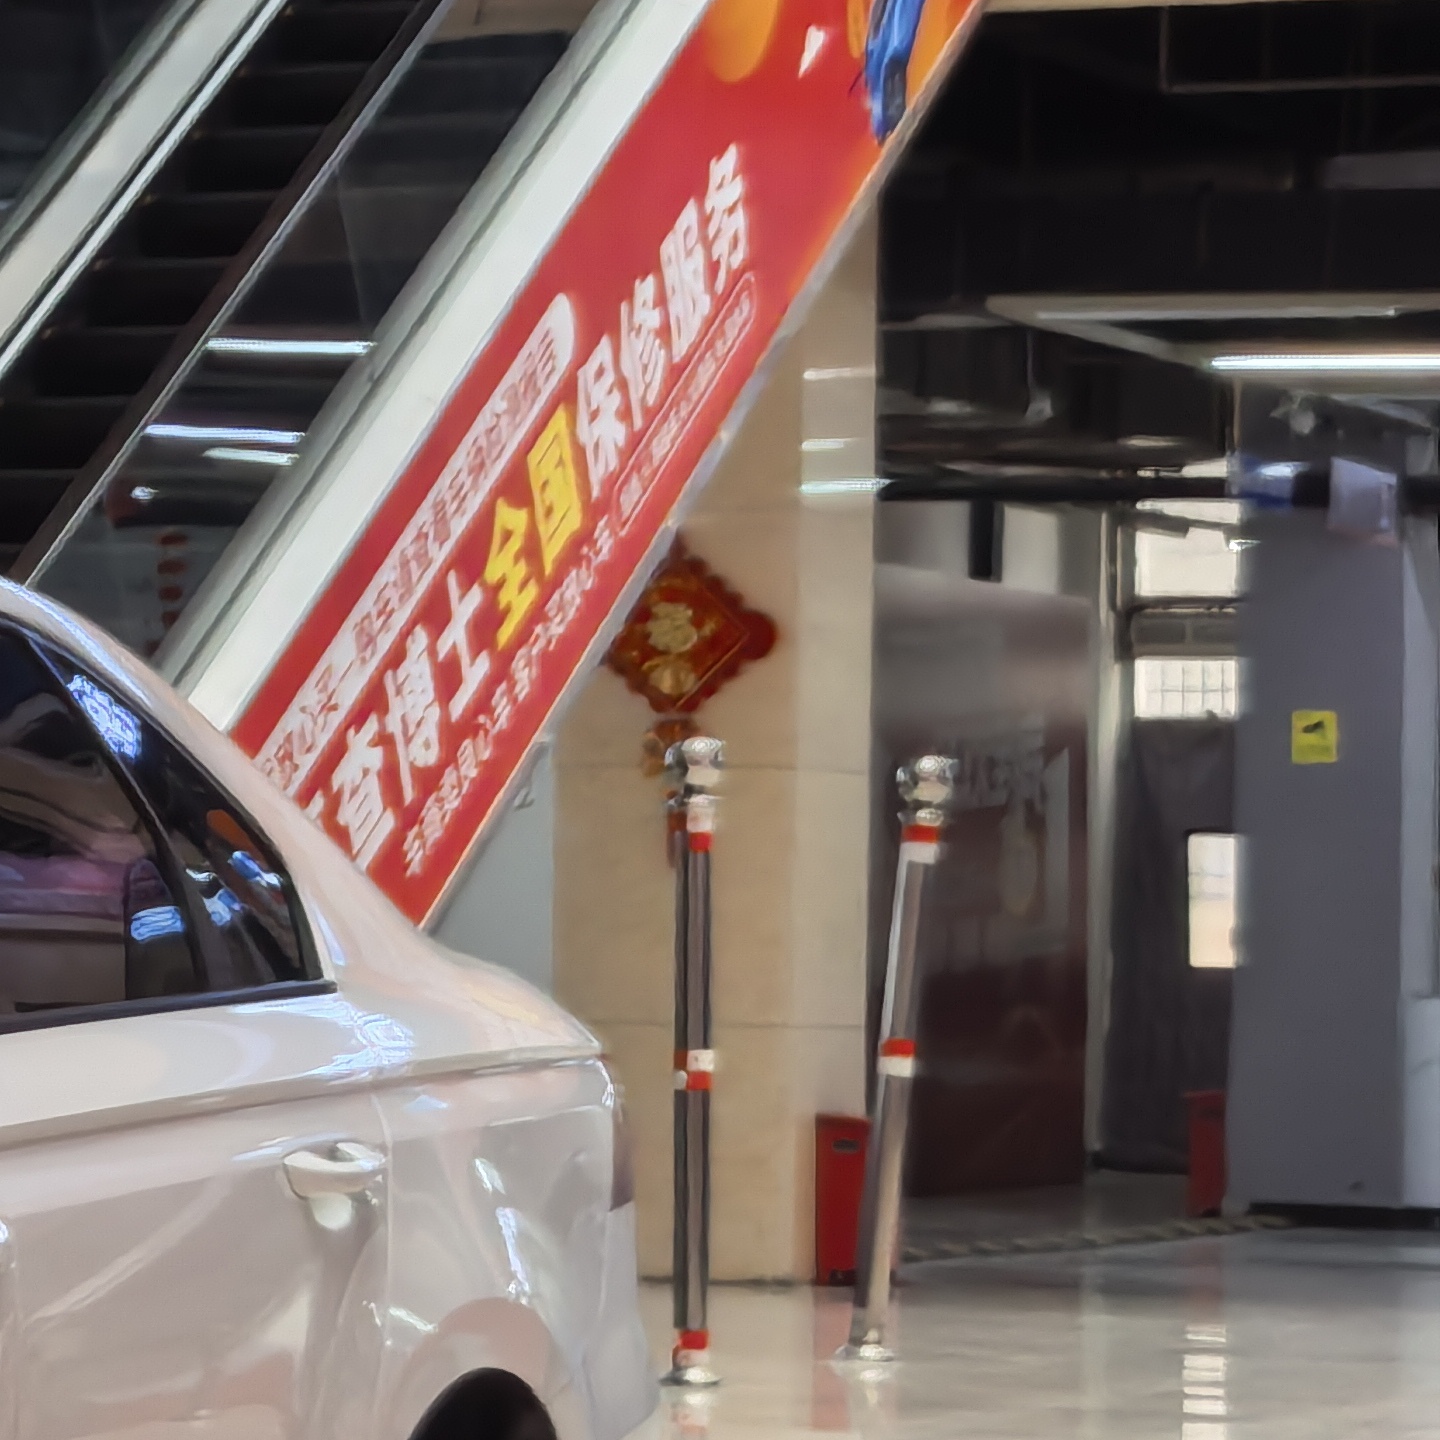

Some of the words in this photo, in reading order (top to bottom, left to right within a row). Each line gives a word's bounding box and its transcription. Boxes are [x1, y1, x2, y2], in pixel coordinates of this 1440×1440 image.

[306, 142, 752, 876] 查博士全国保修服务
